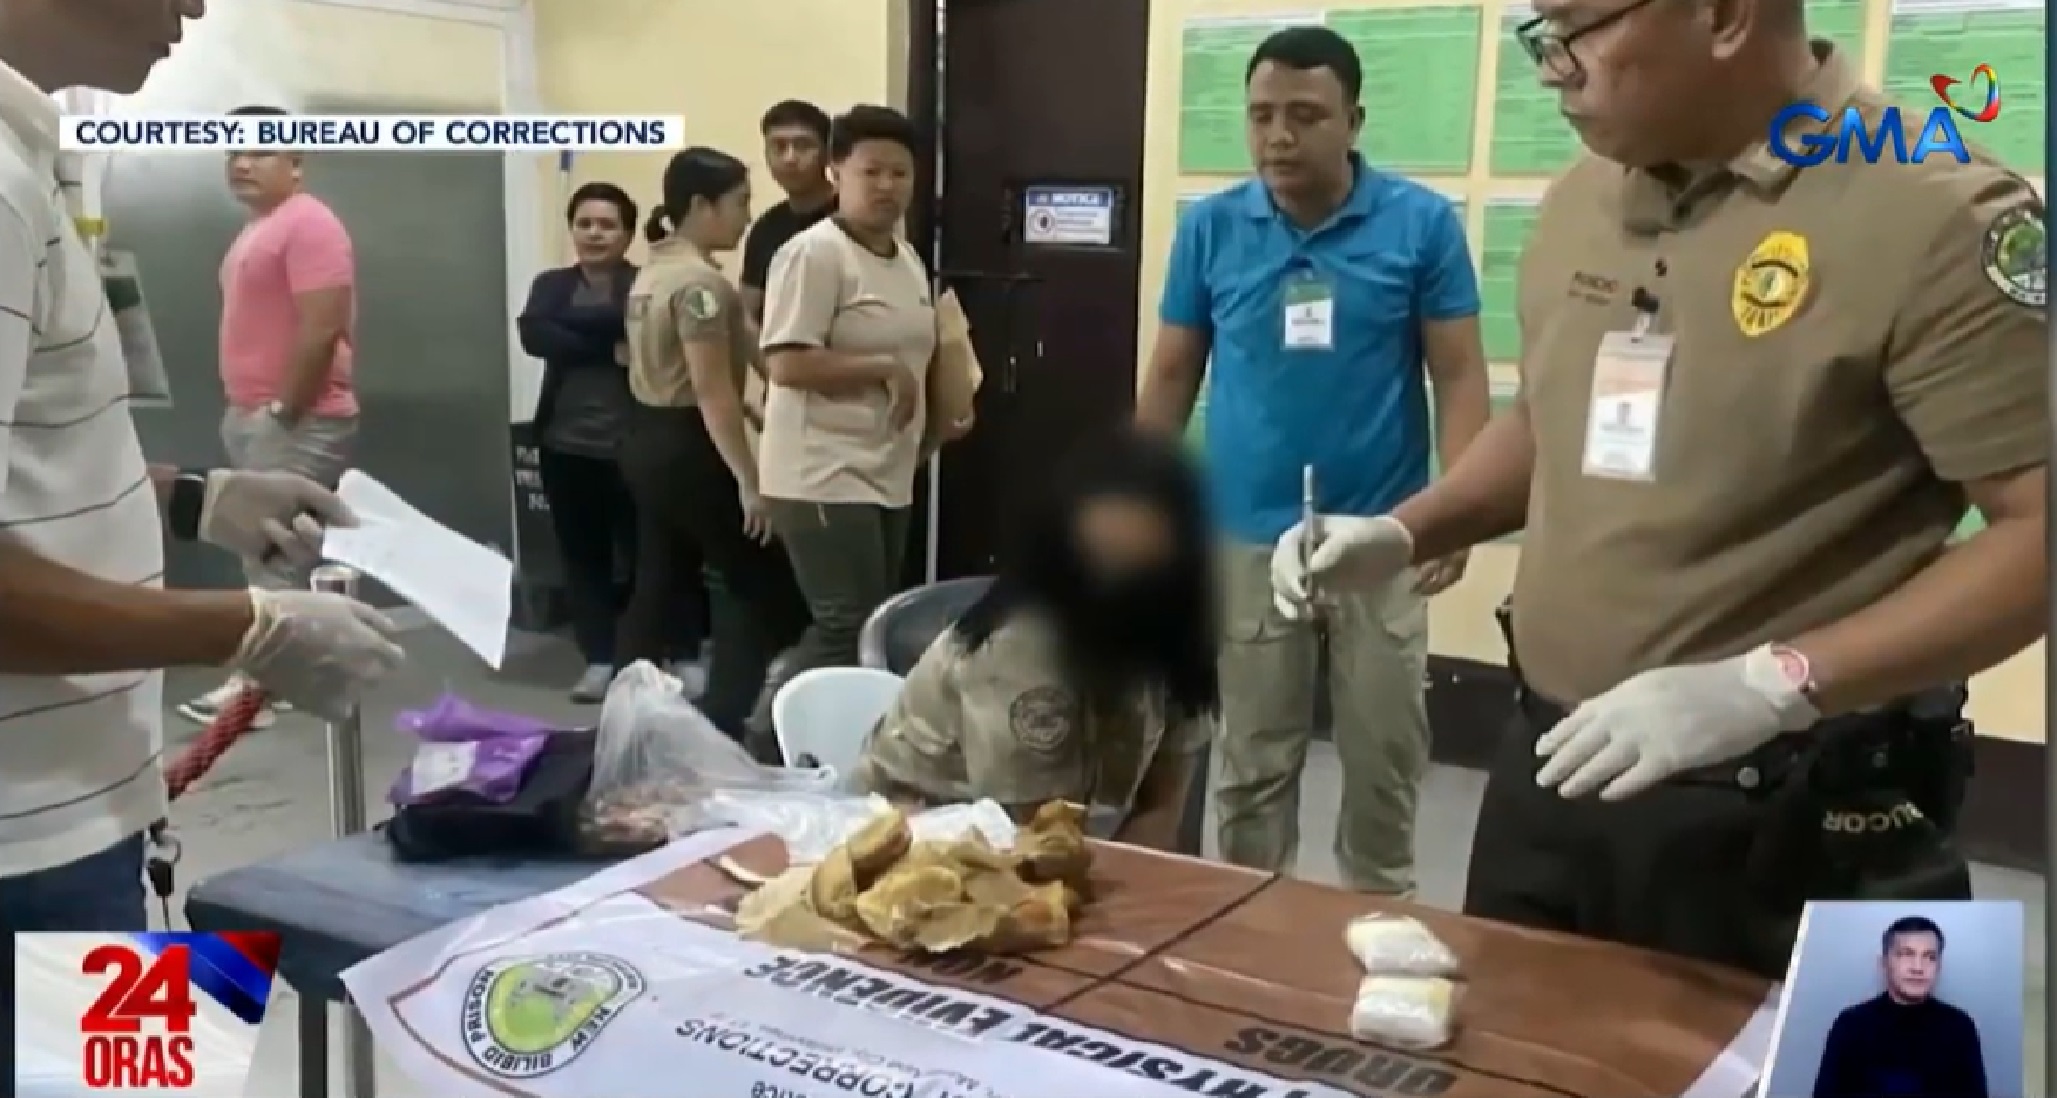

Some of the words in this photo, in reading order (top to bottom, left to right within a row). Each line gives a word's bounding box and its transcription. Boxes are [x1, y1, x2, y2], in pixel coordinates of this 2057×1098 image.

[467, 970, 496, 1043] PRISON
[743, 955, 1012, 1037] EVIDENCE
[1224, 1028, 1458, 1096] DRUGS
